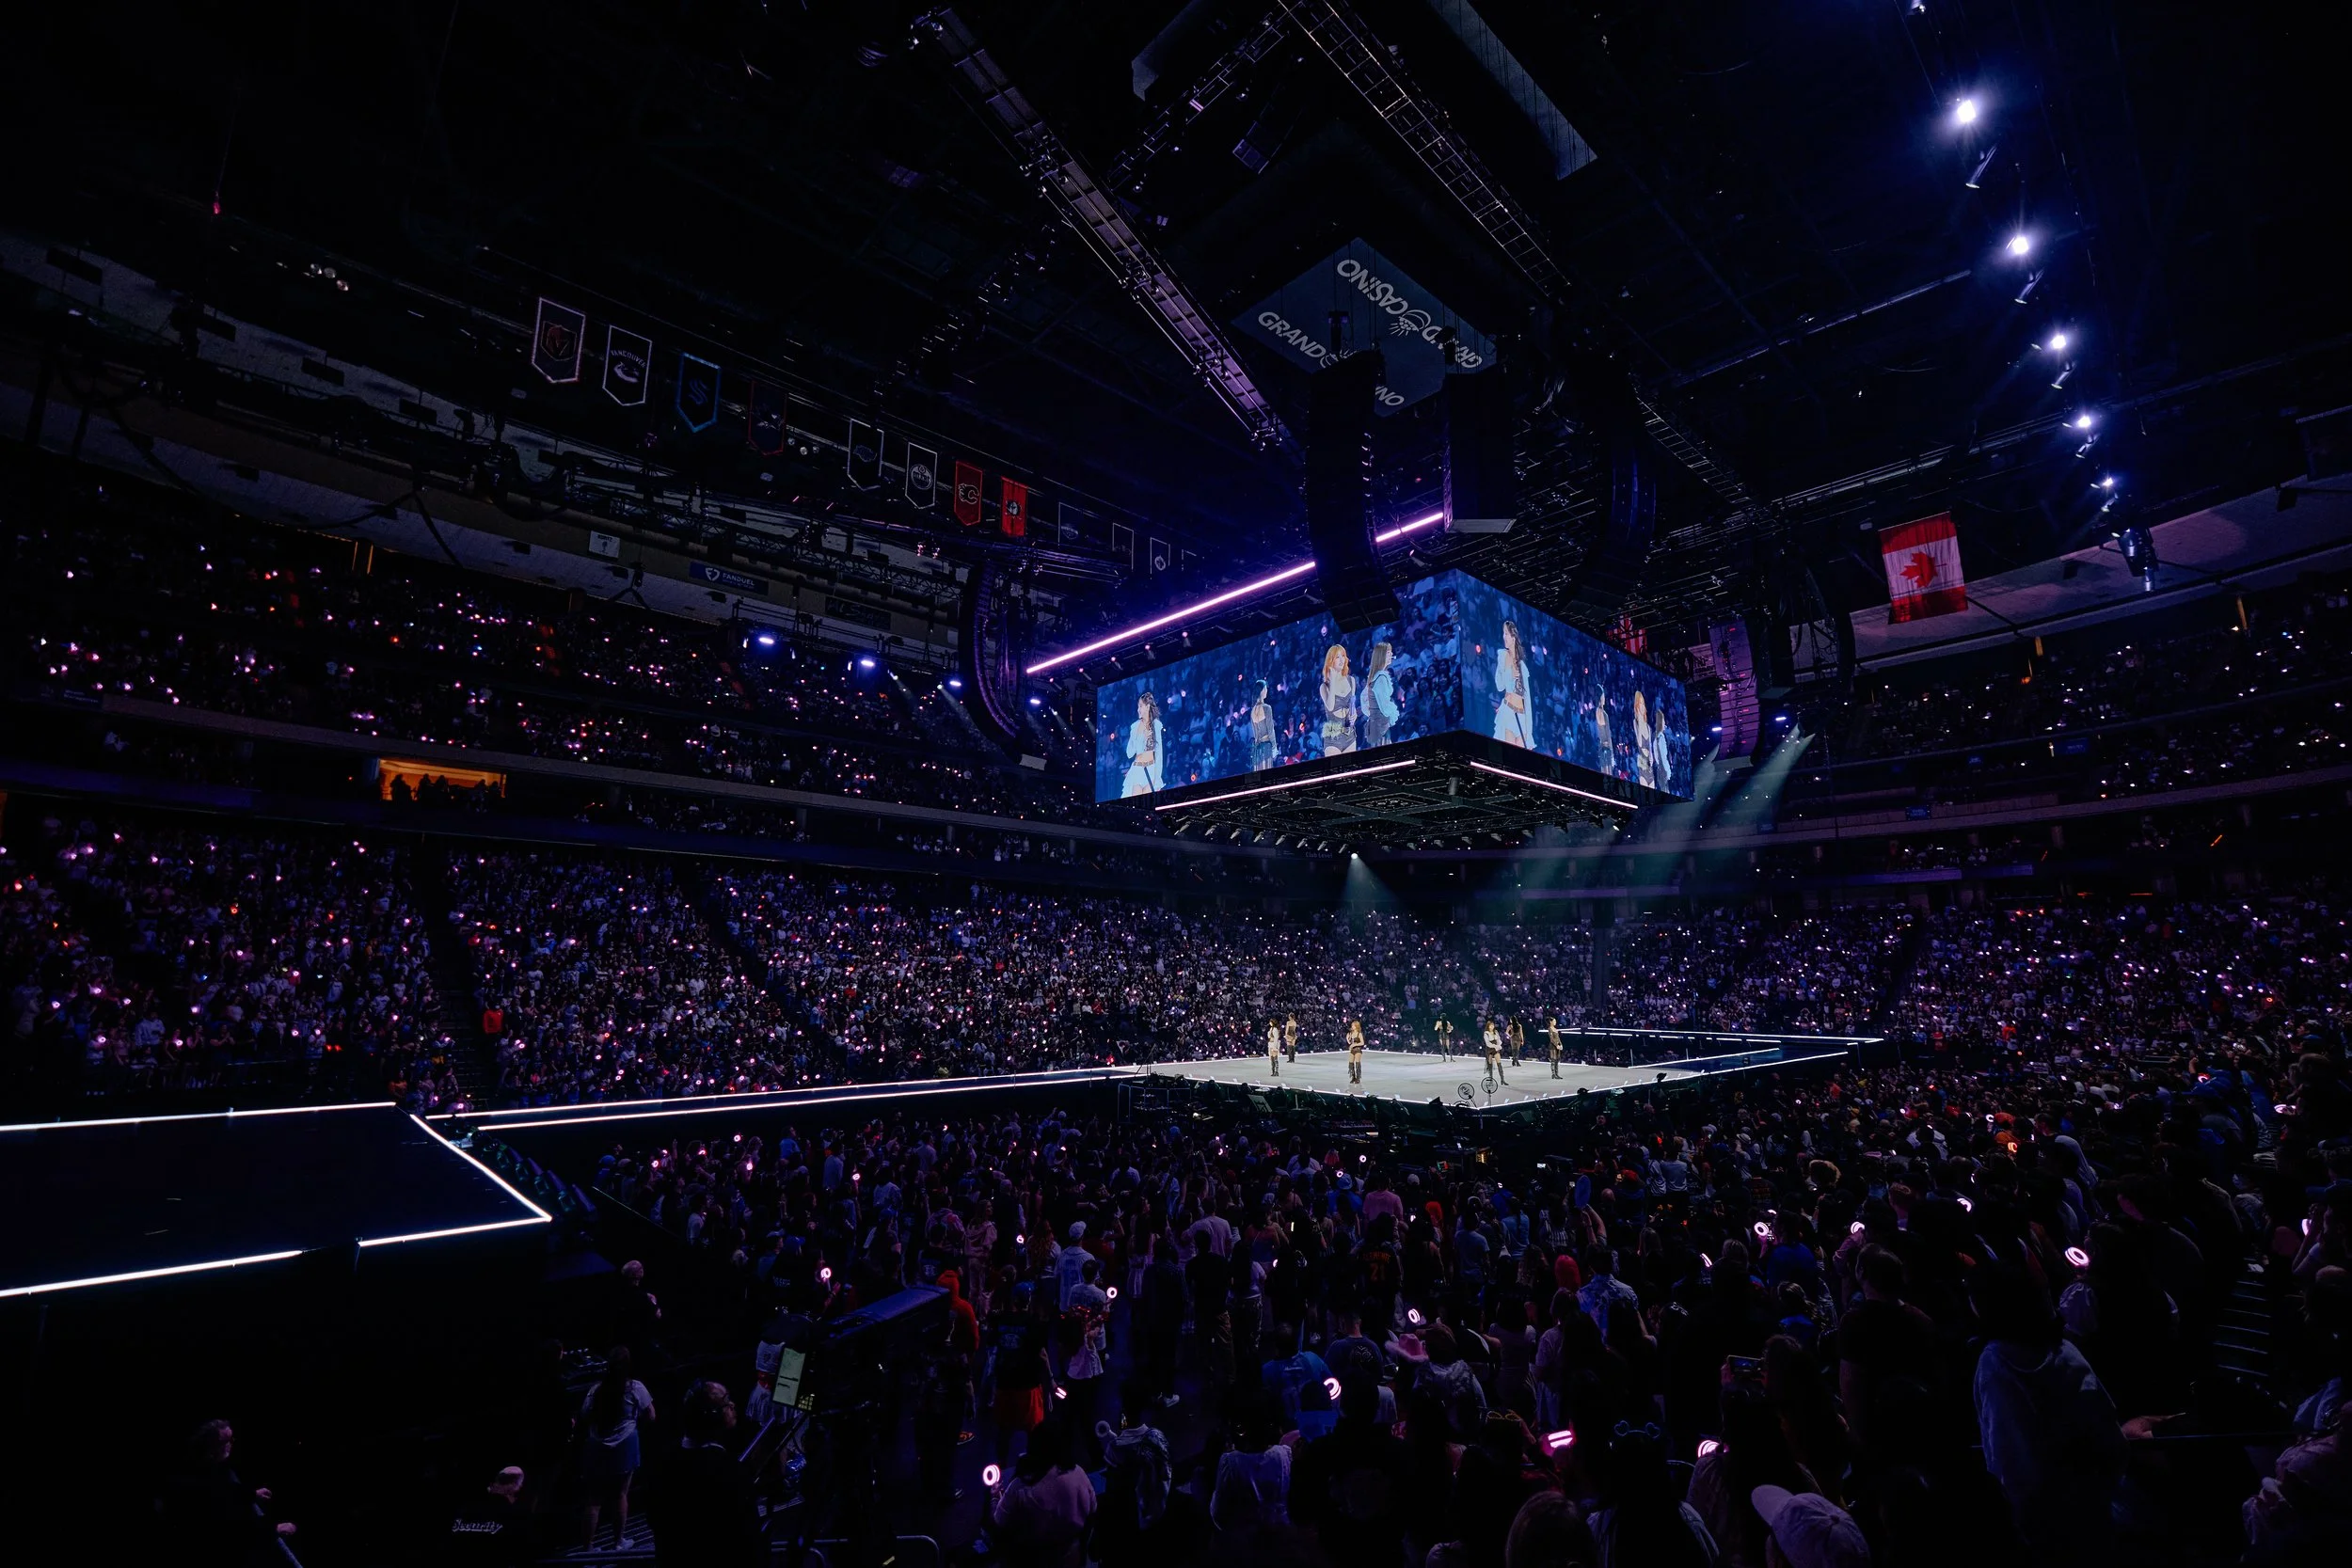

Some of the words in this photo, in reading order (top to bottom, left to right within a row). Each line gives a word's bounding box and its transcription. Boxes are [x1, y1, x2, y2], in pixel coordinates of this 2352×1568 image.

[1337, 259, 1409, 315] CASINO
[1258, 311, 1327, 360] GRAND
[1422, 325, 1483, 369] GRD
[610, 349, 646, 370] VANCOUVER
[723, 572, 755, 586] FANDUEL
